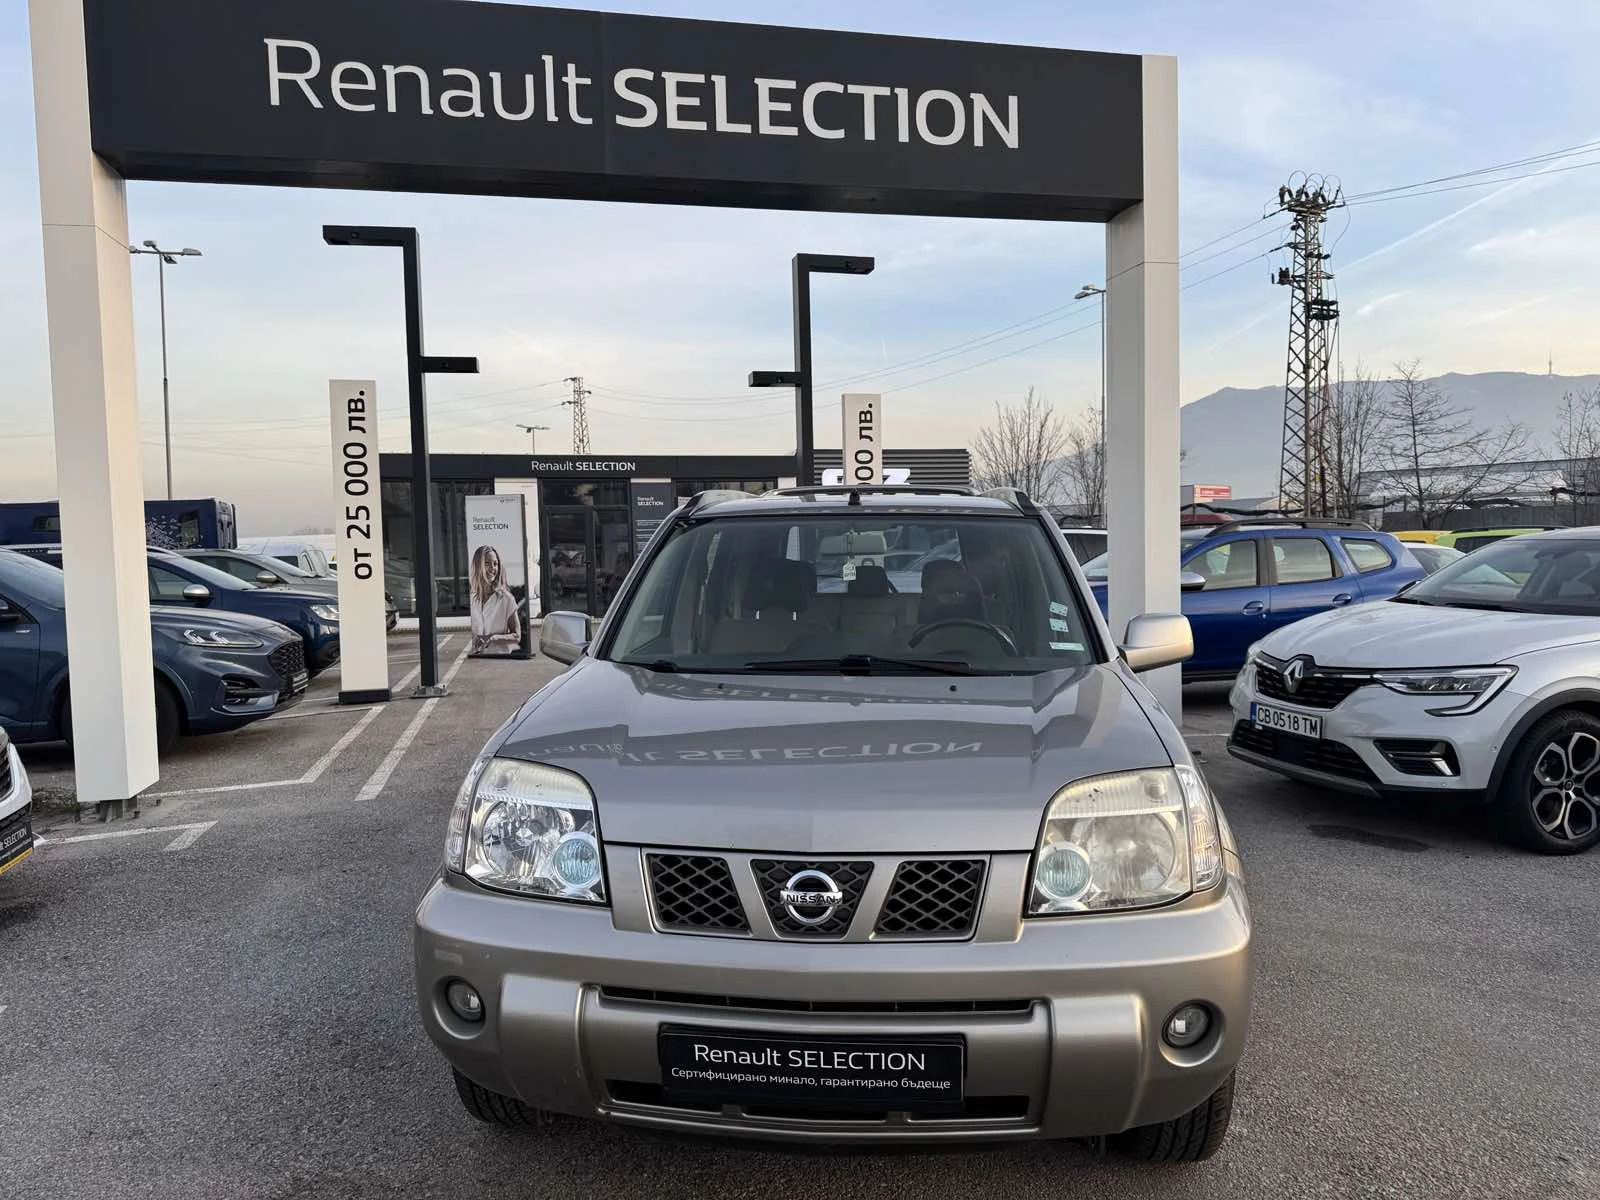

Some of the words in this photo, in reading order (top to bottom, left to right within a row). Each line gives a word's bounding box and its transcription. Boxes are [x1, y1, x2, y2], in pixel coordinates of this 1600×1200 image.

[264, 39, 592, 126] Renault
[614, 69, 1019, 149] SELECTION
[347, 390, 367, 434] лв.
[858, 403, 874, 442] лв.
[342, 442, 369, 497] 000
[531, 461, 574, 471] Renault
[575, 462, 636, 471] SELECTION
[854, 449, 875, 485] 00
[346, 505, 371, 540] 25
[353, 548, 373, 580] от
[1257, 708, 1271, 724] CB
[1273, 711, 1299, 731] 0518
[1302, 717, 1318, 736] TM
[786, 894, 836, 904] NISSAN
[694, 1044, 782, 1067] Renault
[788, 1050, 925, 1071] SELECTION
[671, 1067, 767, 1083] Сертифицирано
[769, 1075, 818, 1087] минало,
[820, 1078, 898, 1090] гарантирано
[901, 1077, 951, 1090] бъдеще
